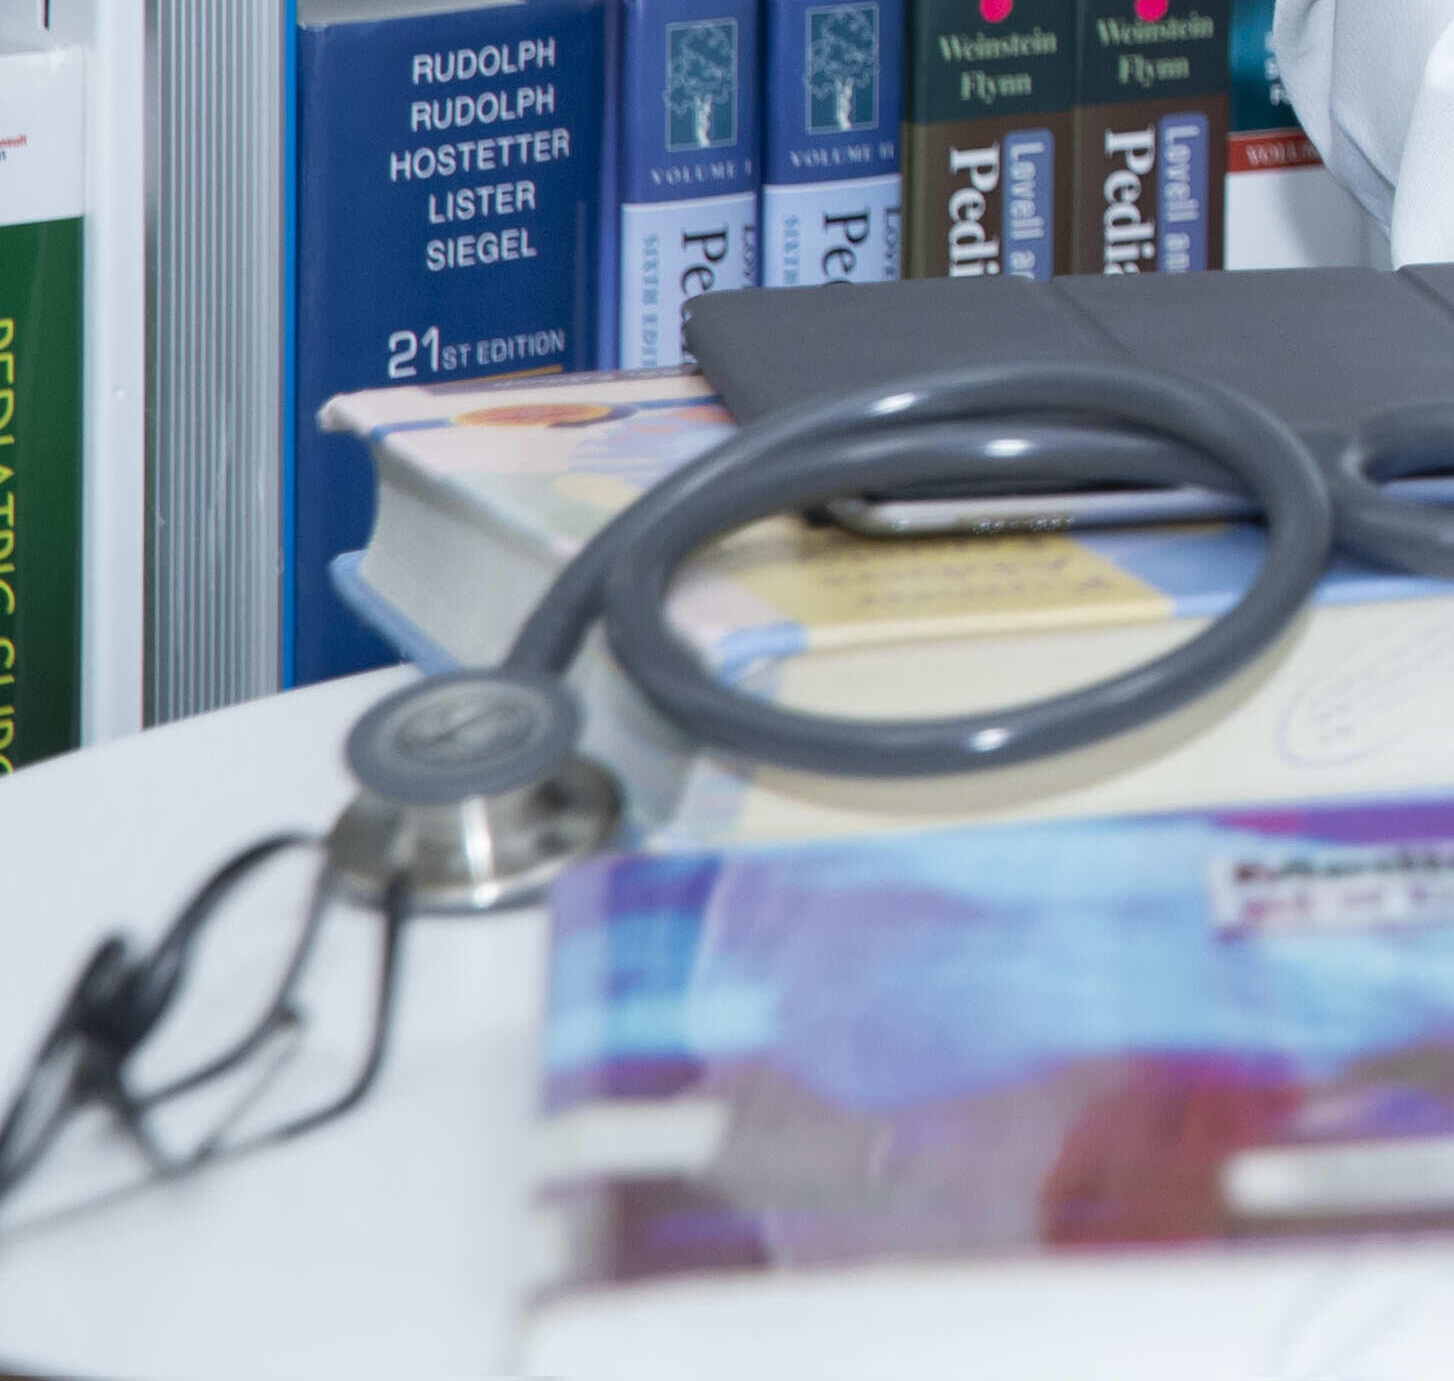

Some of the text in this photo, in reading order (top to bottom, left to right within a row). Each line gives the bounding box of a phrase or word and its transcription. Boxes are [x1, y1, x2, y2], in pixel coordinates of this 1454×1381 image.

[938, 26, 1059, 63] Weinstein
[1096, 11, 1215, 47] Weinstein
[412, 36, 557, 86] RUDOLPH
[1117, 53, 1191, 88] Flynn
[411, 84, 556, 133] RUDOLPH
[958, 69, 1033, 105] Flynn
[389, 127, 572, 183] HOSTETTER
[650, 161, 739, 186] VOLUME
[788, 143, 874, 169] VOLUME
[1163, 125, 1199, 223] Lovell
[427, 180, 537, 225] LISTER
[1009, 141, 1046, 242] Lovell
[426, 228, 538, 273] SIEGEL
[821, 205, 874, 286] Pe
[387, 325, 566, 379] 21ST EDITION
